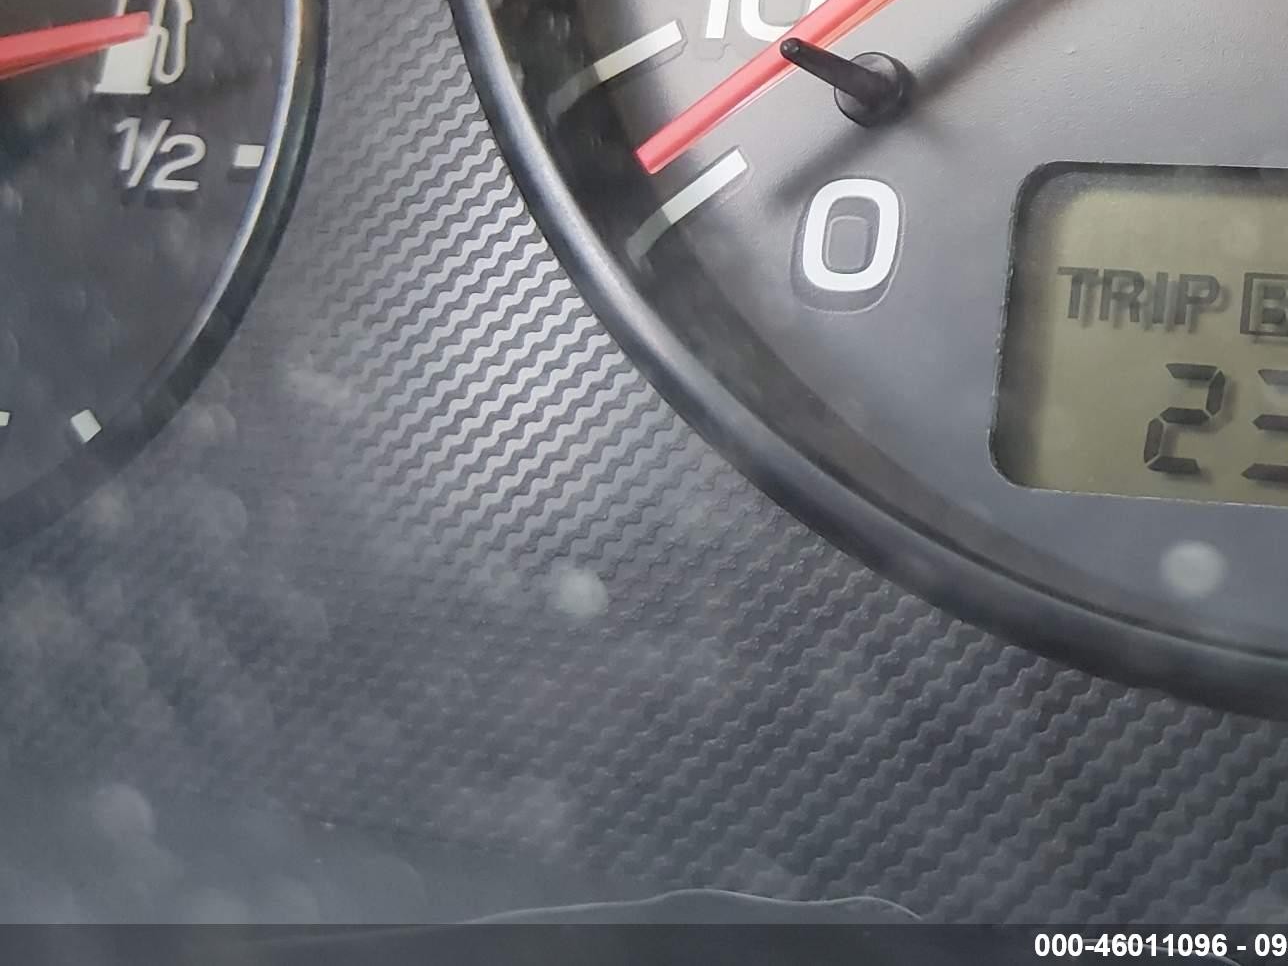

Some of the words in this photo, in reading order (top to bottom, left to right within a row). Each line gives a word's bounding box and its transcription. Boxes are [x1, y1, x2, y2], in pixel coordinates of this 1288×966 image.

[115, 117, 206, 192] 1/2
[802, 178, 901, 292] 0
[1057, 266, 1226, 328] TRIP
